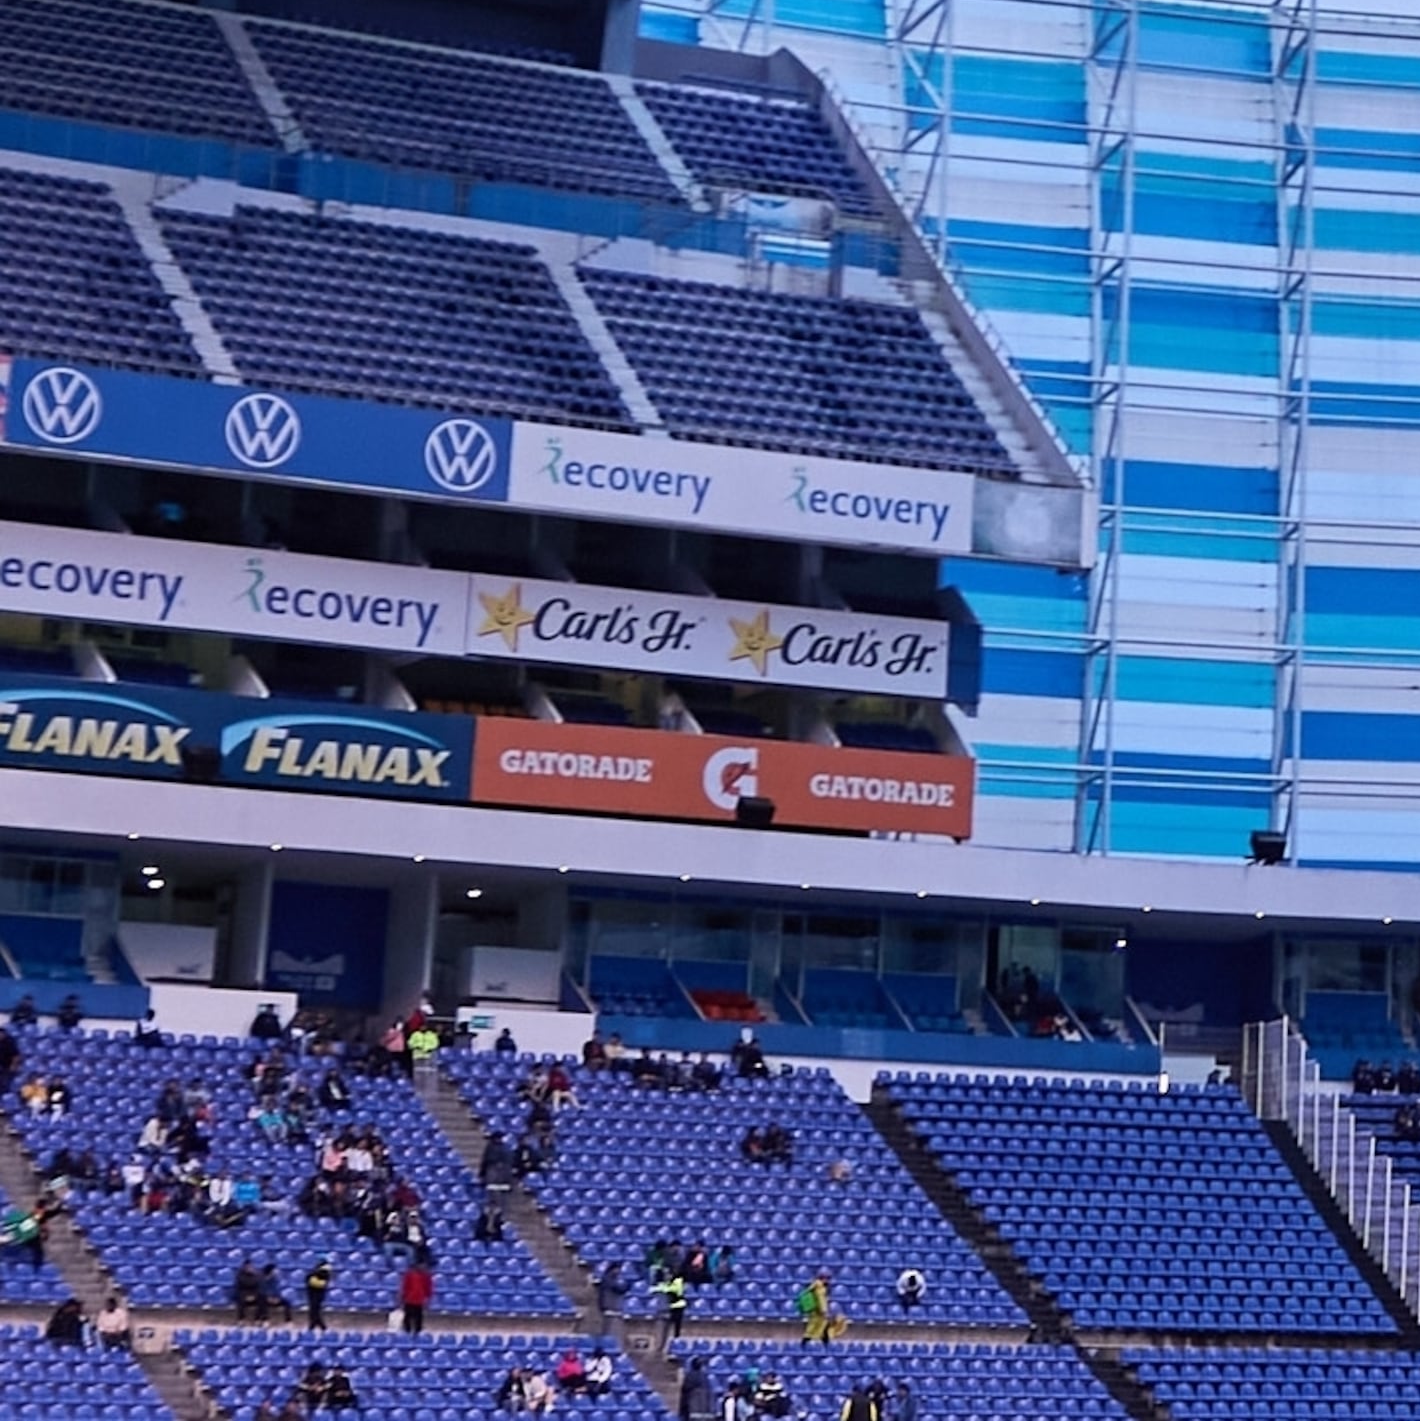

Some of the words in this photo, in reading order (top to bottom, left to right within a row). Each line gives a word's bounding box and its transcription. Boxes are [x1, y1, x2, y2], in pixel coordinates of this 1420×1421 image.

[0, 557, 184, 621] ecovery
[533, 598, 640, 645] Carl's
[641, 609, 692, 653] Jr.
[780, 623, 884, 670] Carl's
[885, 633, 934, 675] Jr.
[244, 727, 450, 786] FLANAX
[500, 748, 652, 782] GATORADE
[810, 773, 954, 807] GATORADE
